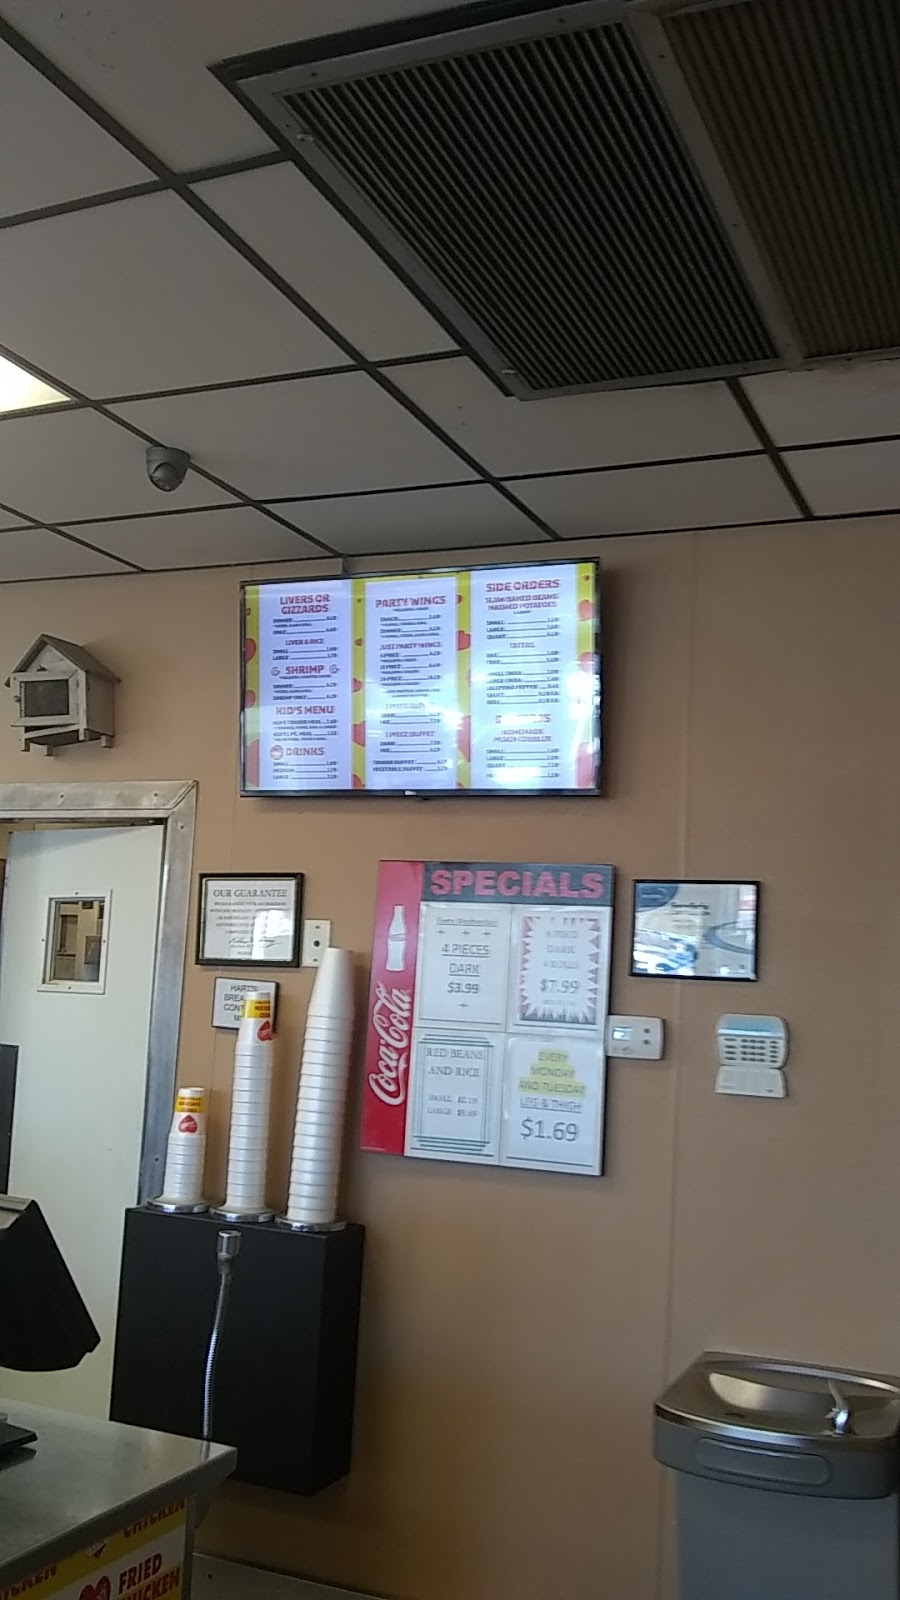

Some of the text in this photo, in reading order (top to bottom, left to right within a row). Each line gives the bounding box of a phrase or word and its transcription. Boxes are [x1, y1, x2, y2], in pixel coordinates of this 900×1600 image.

[486, 579, 560, 593] SIDE ORDERS
[280, 594, 331, 605] LIVERS OR
[375, 595, 446, 608] PARTY WINGS
[281, 604, 329, 615] GIZZARDS
[488, 601, 556, 611] MASHED POTATOES
[285, 665, 324, 675] SHRIMP
[276, 705, 334, 715] KID'S MENU
[286, 747, 325, 756] DRINKS
[430, 869, 605, 899] SPECIALS
[213, 888, 288, 898] OUR GUARANTEE
[441, 944, 491, 956] 4 PIECES
[546, 945, 576, 954] DARK
[448, 962, 480, 974] DARK
[447, 981, 481, 994] $3.99
[539, 979, 581, 994] $7.99
[224, 993, 244, 1002] BREA
[223, 1003, 245, 1012] CONT
[426, 1047, 483, 1060] RED BEANS
[538, 1051, 569, 1063] EVERY
[428, 1066, 480, 1078] AND RICE
[530, 1066, 576, 1078] MONDAY
[518, 1079, 586, 1095] AND TUESDAY
[520, 1097, 582, 1111] LEG & THIGH
[427, 1107, 453, 1116] LARGE
[520, 1116, 580, 1142] $1.69
[118, 1552, 163, 1595] FRIED
[121, 1567, 181, 1600] HICKEN
